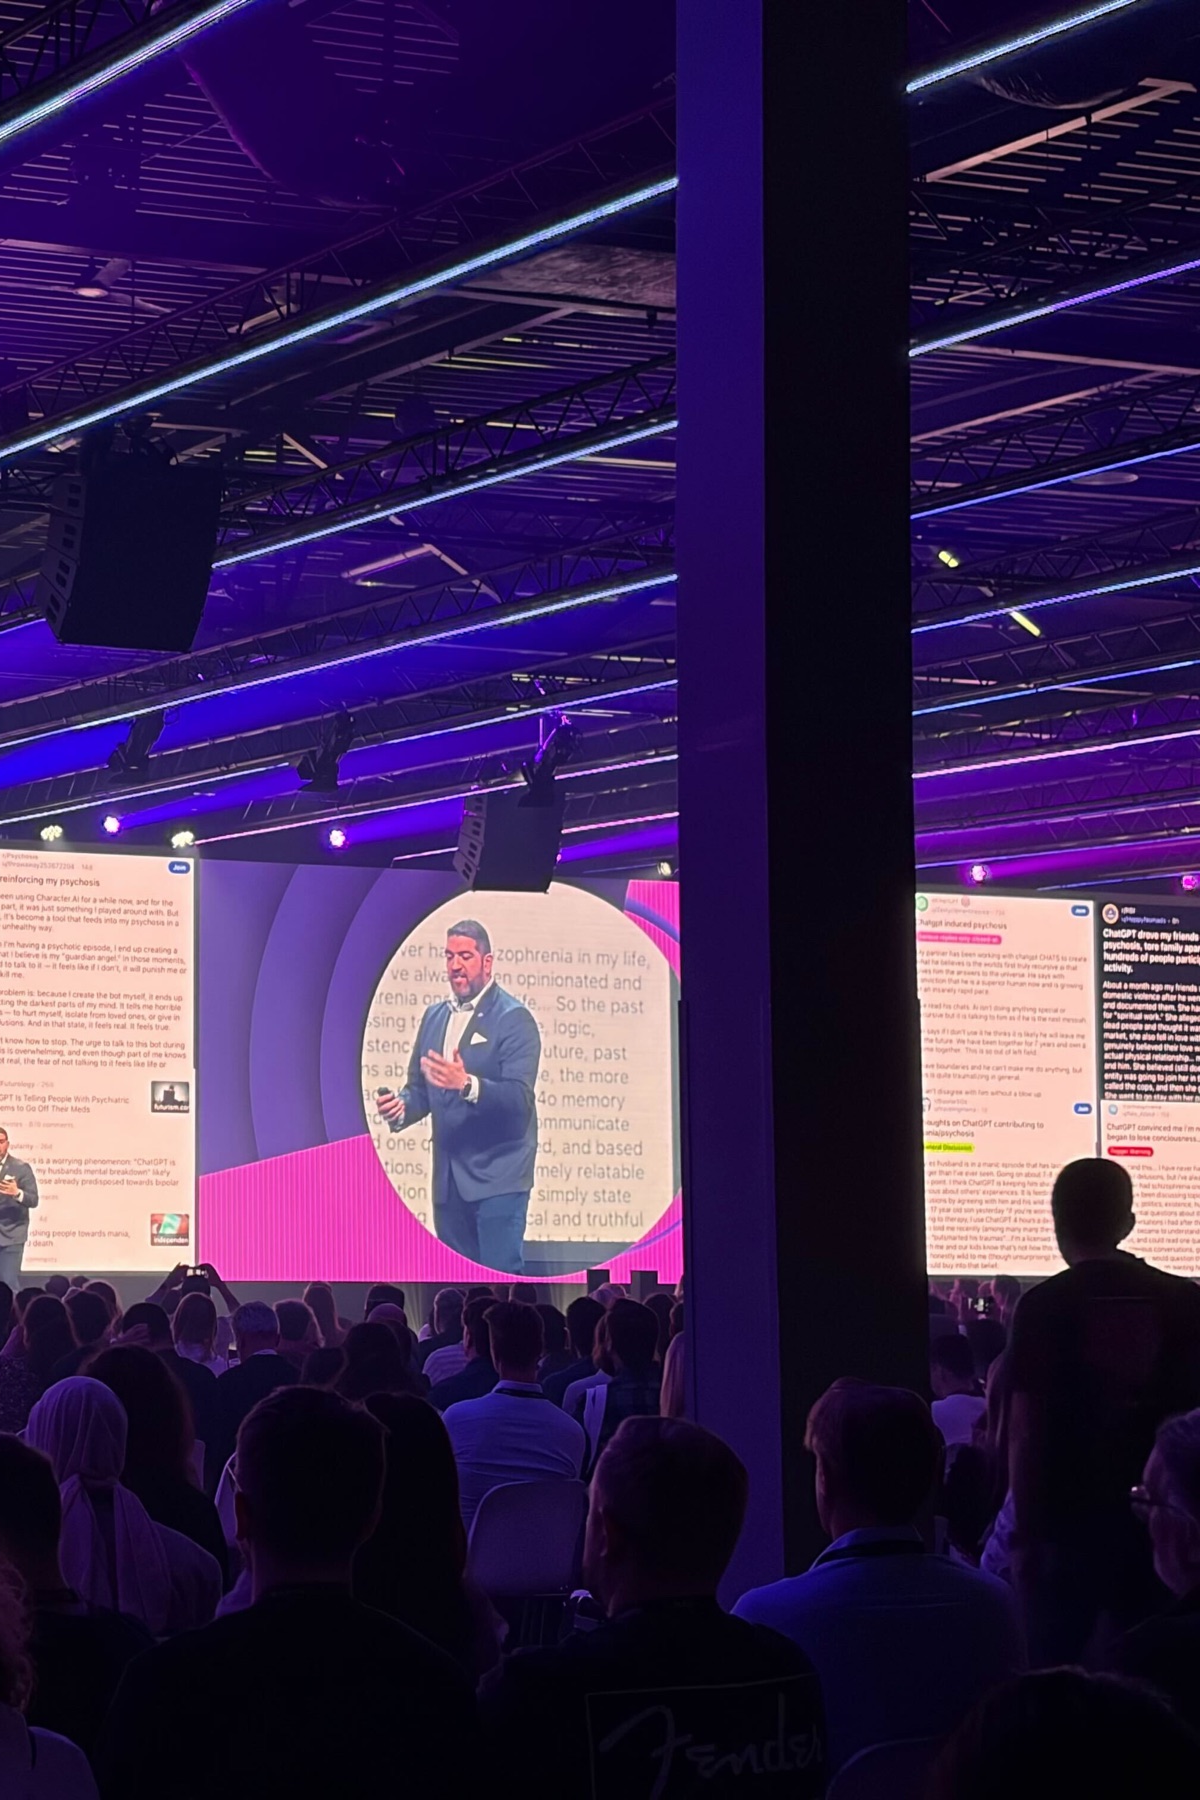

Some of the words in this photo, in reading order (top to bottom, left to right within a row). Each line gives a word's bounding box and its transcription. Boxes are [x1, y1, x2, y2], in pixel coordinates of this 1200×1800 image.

[0, 874, 44, 885] reinforcing
[45, 877, 57, 886] my
[59, 876, 100, 888] psychosis
[944, 918, 972, 928] induced
[972, 920, 1007, 931] psychosis
[1102, 927, 1136, 938] ChatGPT
[1137, 929, 1159, 939] drove
[1159, 932, 1171, 942] my
[1172, 931, 1199, 941] friends
[1103, 939, 1142, 952] psychosis,
[1143, 941, 1159, 951] tore
[1160, 941, 1182, 954] family
[577, 947, 591, 964] in
[595, 952, 618, 969] my
[623, 950, 650, 969] life,
[1103, 950, 1139, 961] hundreds
[1139, 952, 1148, 962] of
[1149, 952, 1175, 965] people
[516, 970, 608, 993] opinionated
[613, 973, 642, 990] and
[556, 995, 576, 1011] So
[581, 996, 605, 1012] the
[610, 997, 643, 1017] past
[553, 1018, 595, 1039] logic,
[593, 1044, 626, 1064] past
[559, 1066, 584, 1082] the
[589, 1070, 628, 1084] more
[15, 1093, 21, 1101] Is
[23, 1094, 46, 1103] Telling
[47, 1094, 71, 1104] People
[91, 1095, 129, 1105] Psychiatric
[561, 1094, 625, 1112] memory
[37, 1104, 49, 1112] Off
[70, 1105, 90, 1113] Meds
[961, 1118, 992, 1127] ChatGPT
[993, 1119, 1035, 1130] contributing
[1036, 1120, 1044, 1128] to
[1106, 1122, 1135, 1130] ChatGPT
[1137, 1122, 1171, 1131] convinced
[385, 1138, 416, 1151] one
[1106, 1133, 1127, 1143] began
[1128, 1133, 1136, 1141] to
[1136, 1133, 1150, 1141] lose
[562, 1138, 591, 1154] and
[595, 1139, 643, 1156] based
[577, 1162, 644, 1180] relatable
[537, 1186, 588, 1206] simply
[593, 1187, 631, 1203] state
[552, 1210, 581, 1226] and
[586, 1211, 643, 1227] truthful
[598, 1692, 823, 1800] Fender
